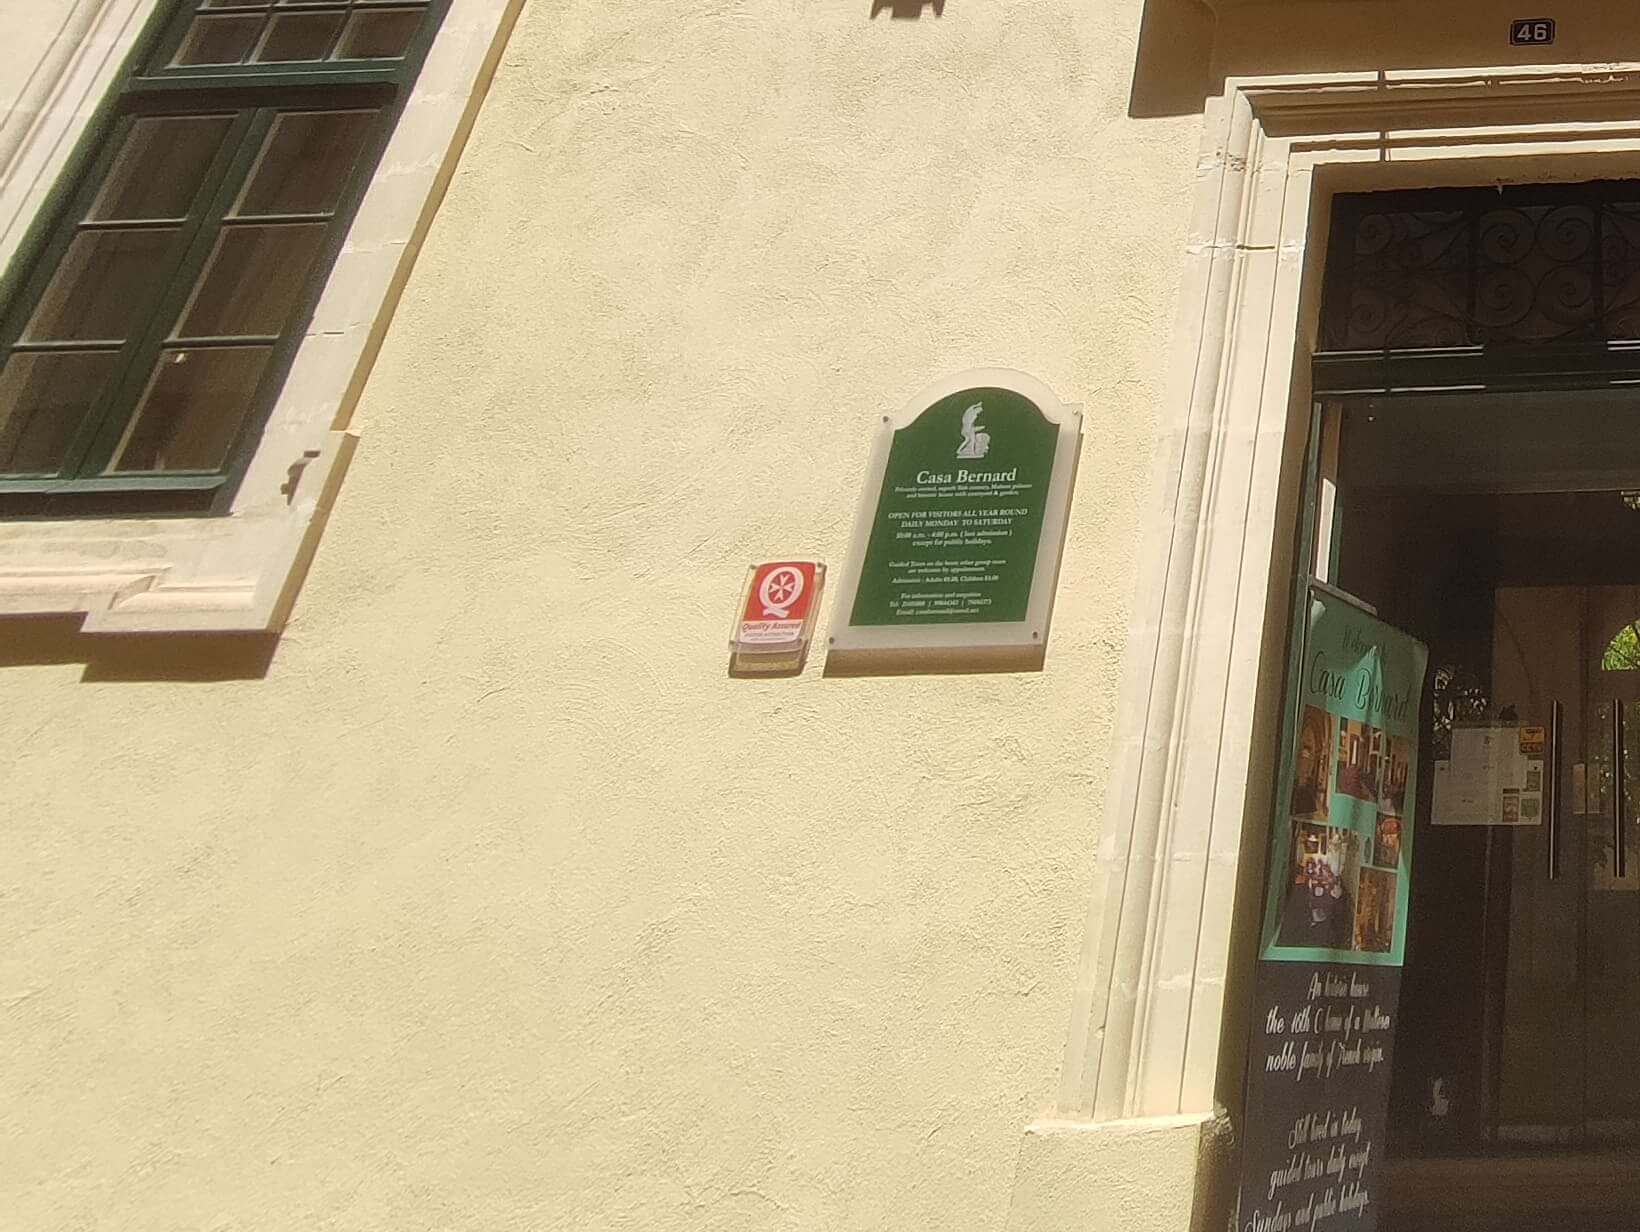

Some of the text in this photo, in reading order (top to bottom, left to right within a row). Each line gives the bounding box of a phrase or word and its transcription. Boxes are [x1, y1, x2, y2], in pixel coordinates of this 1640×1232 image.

[1517, 24, 1548, 40] 46
[917, 468, 1017, 484] Casa Bernard
[929, 510, 961, 518] VISITORS
[1000, 508, 1028, 516] ROUND
[973, 518, 1012, 526] SATURDAY
[1310, 651, 1345, 700] Casa
[1307, 972, 1322, 1000] An
[1265, 1005, 1285, 1034] the
[1291, 1005, 1311, 1033] 16th
[1265, 1041, 1296, 1072] noble
[1267, 1152, 1305, 1201] guided
[1244, 1200, 1292, 1232] Sundays
